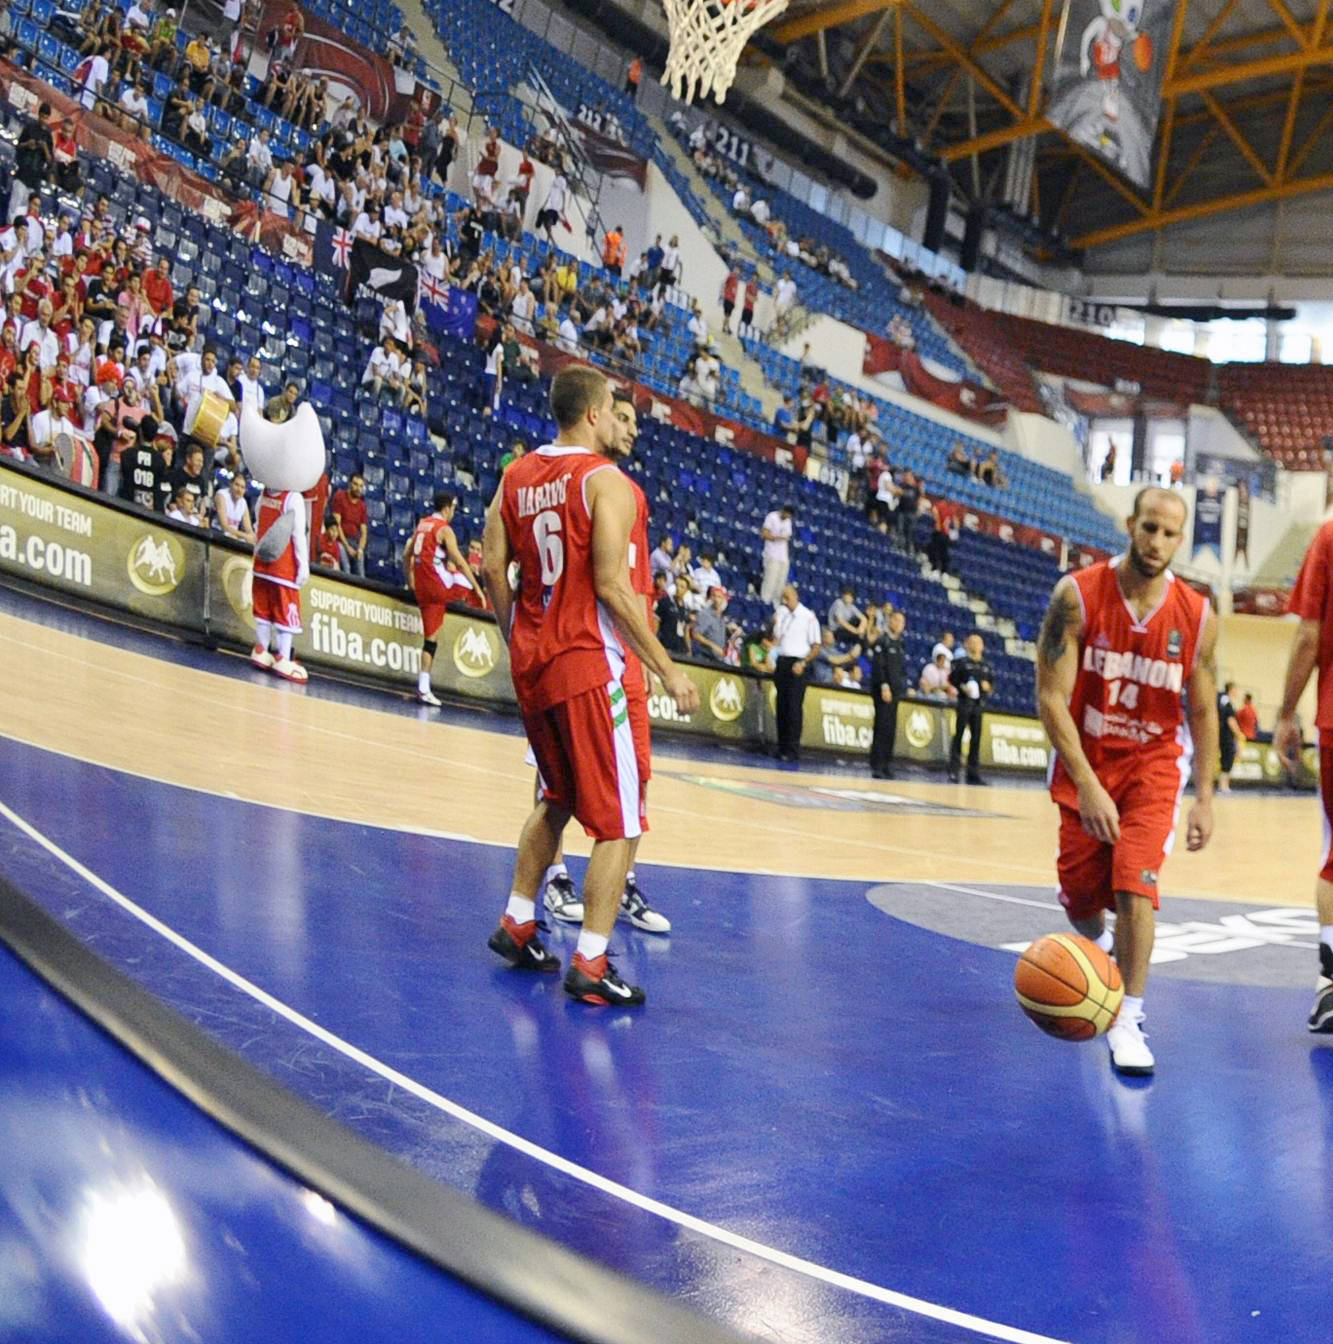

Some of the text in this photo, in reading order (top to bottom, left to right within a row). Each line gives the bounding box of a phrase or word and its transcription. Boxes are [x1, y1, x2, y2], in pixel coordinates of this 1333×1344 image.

[715, 126, 749, 166] 211
[19, 492, 54, 523] YOUR
[55, 505, 92, 537] TEAM
[533, 510, 564, 587] 6
[310, 588, 424, 633] SUPPORT YOUR TEAM
[310, 612, 422, 675] fiba.com
[1083, 645, 1184, 694] LEBANON
[1108, 679, 1140, 710] 14
